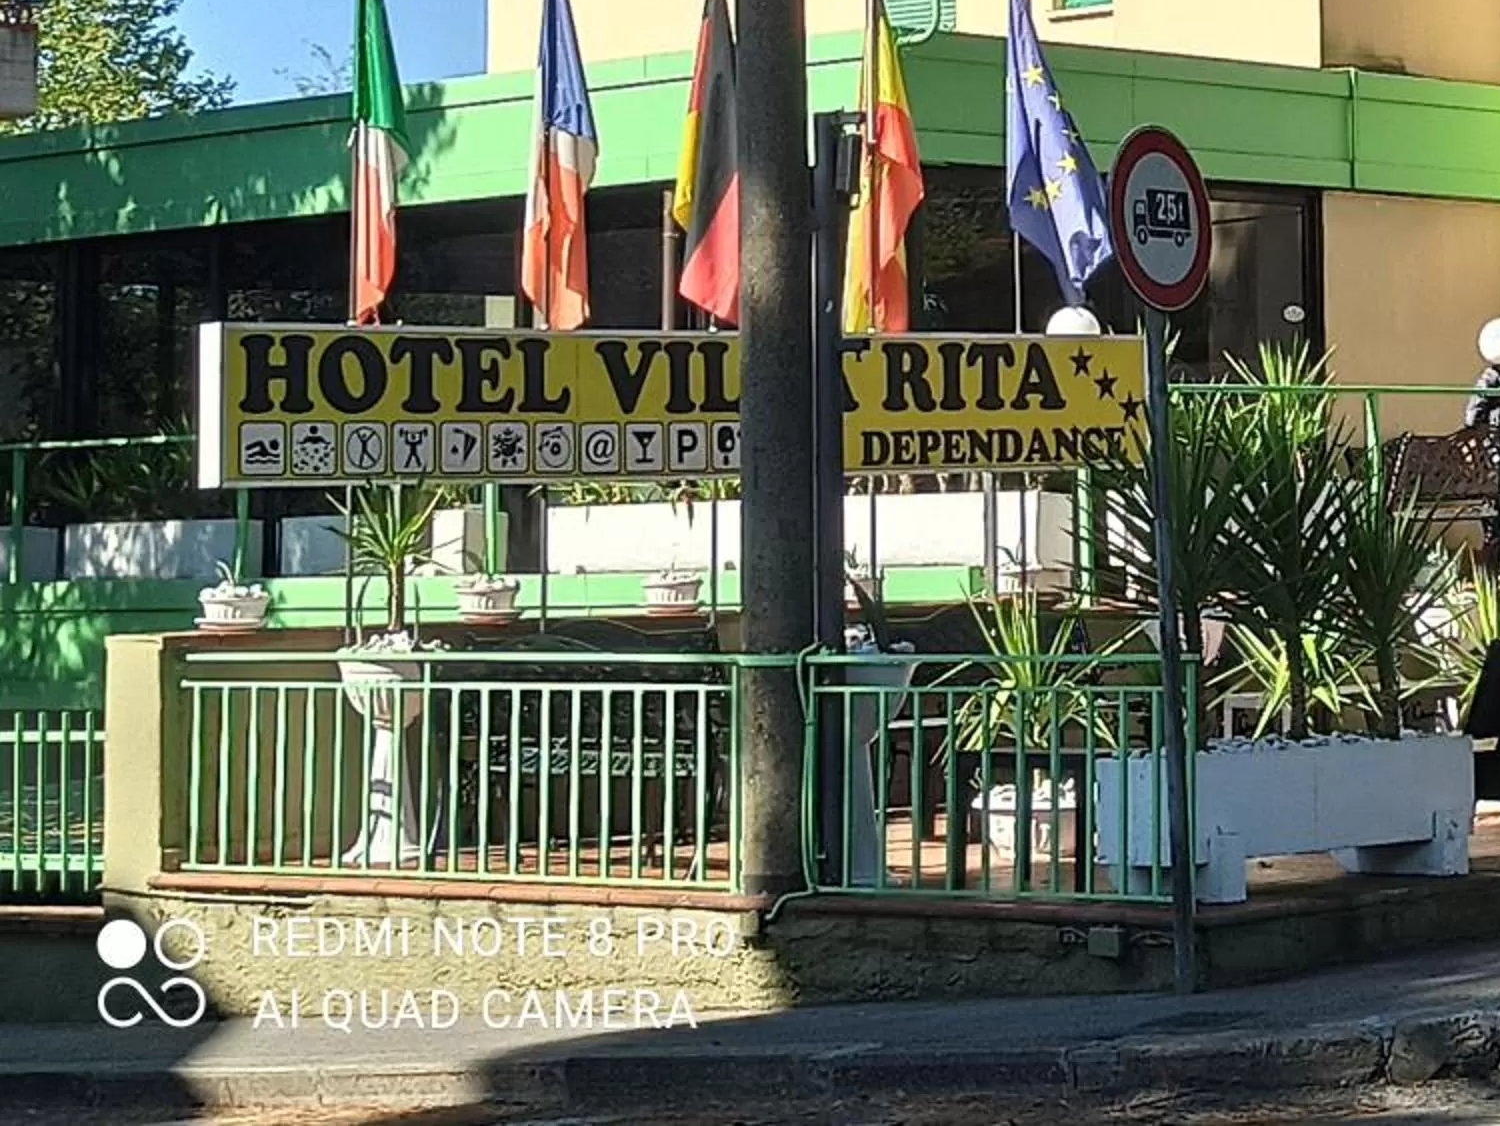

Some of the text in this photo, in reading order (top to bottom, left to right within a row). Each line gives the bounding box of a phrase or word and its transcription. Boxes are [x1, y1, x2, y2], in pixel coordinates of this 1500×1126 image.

[239, 333, 1066, 414] HOTEL VIL RITA
[677, 429, 699, 464] P
